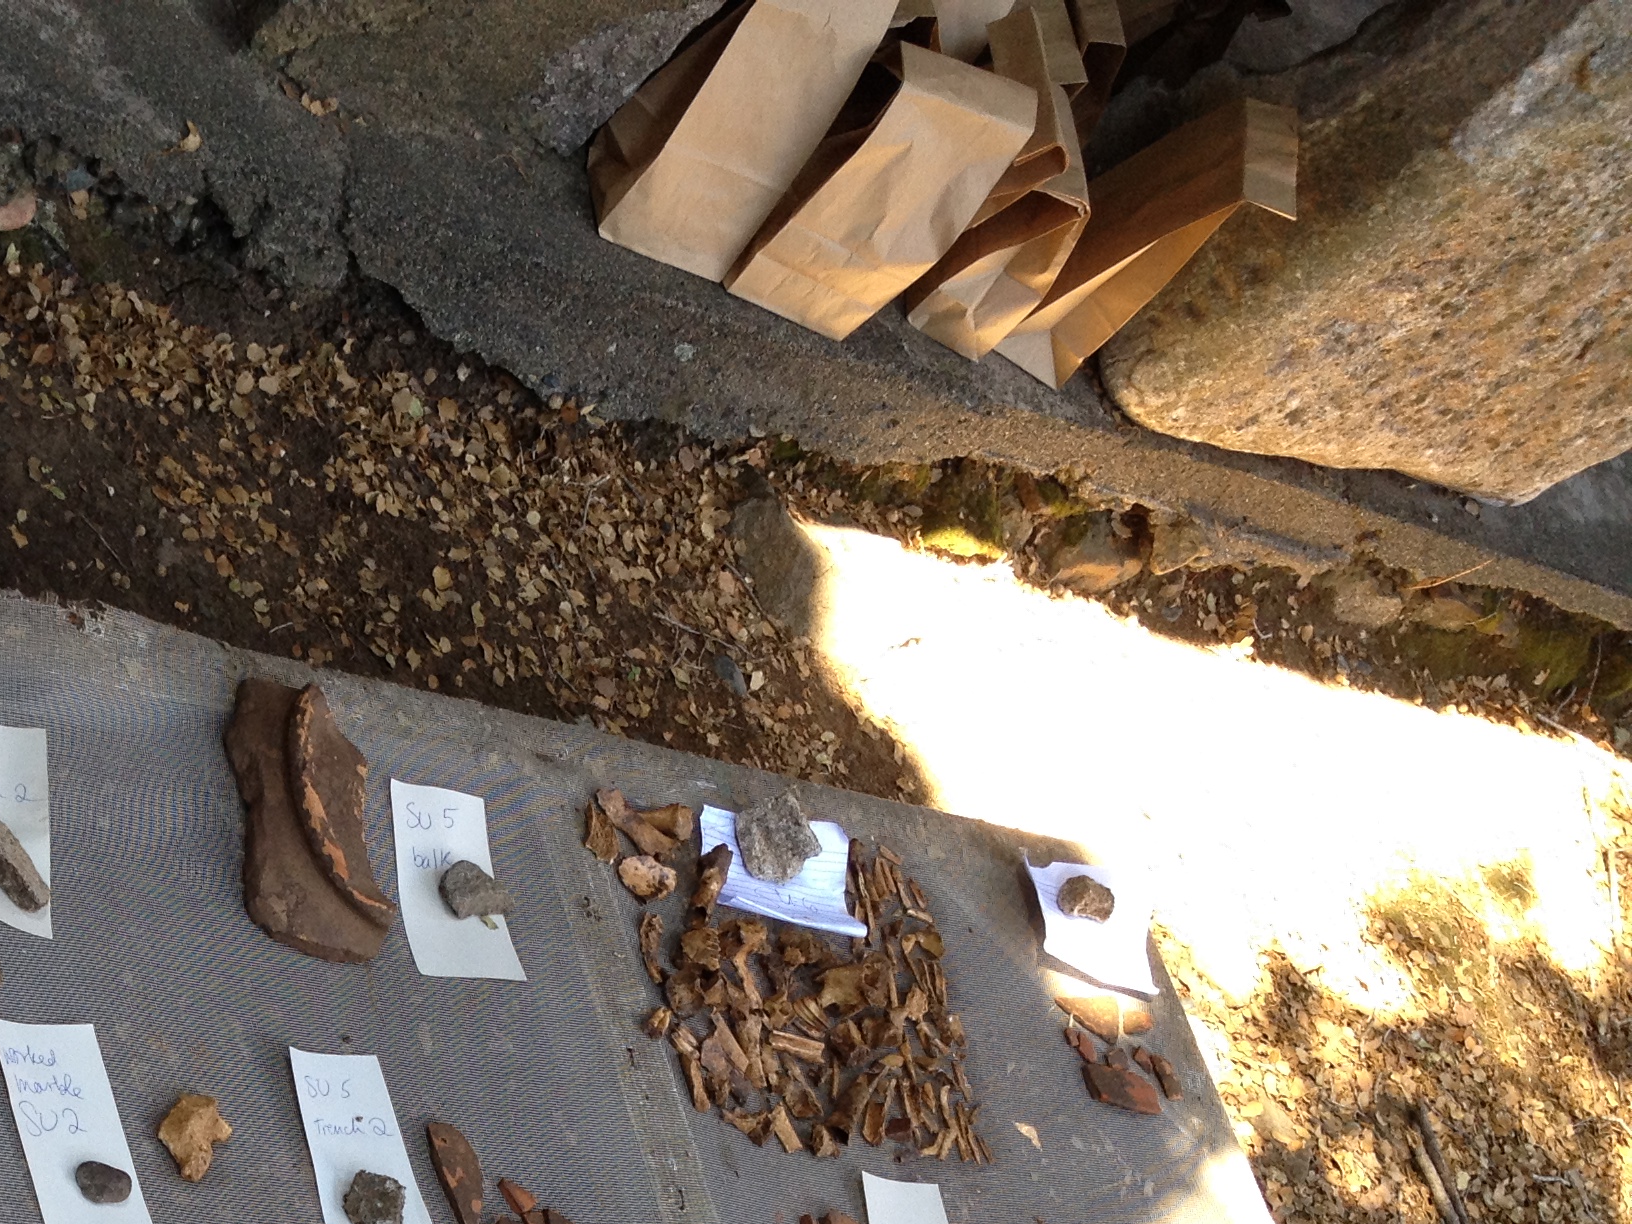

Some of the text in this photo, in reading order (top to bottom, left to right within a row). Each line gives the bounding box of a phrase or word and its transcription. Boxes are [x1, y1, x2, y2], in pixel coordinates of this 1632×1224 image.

[14, 783, 33, 802] 2
[406, 802, 459, 830] SU 5
[412, 846, 451, 870] balk
[304, 1075, 330, 1099] SU
[314, 1117, 394, 1137] Trench 2
